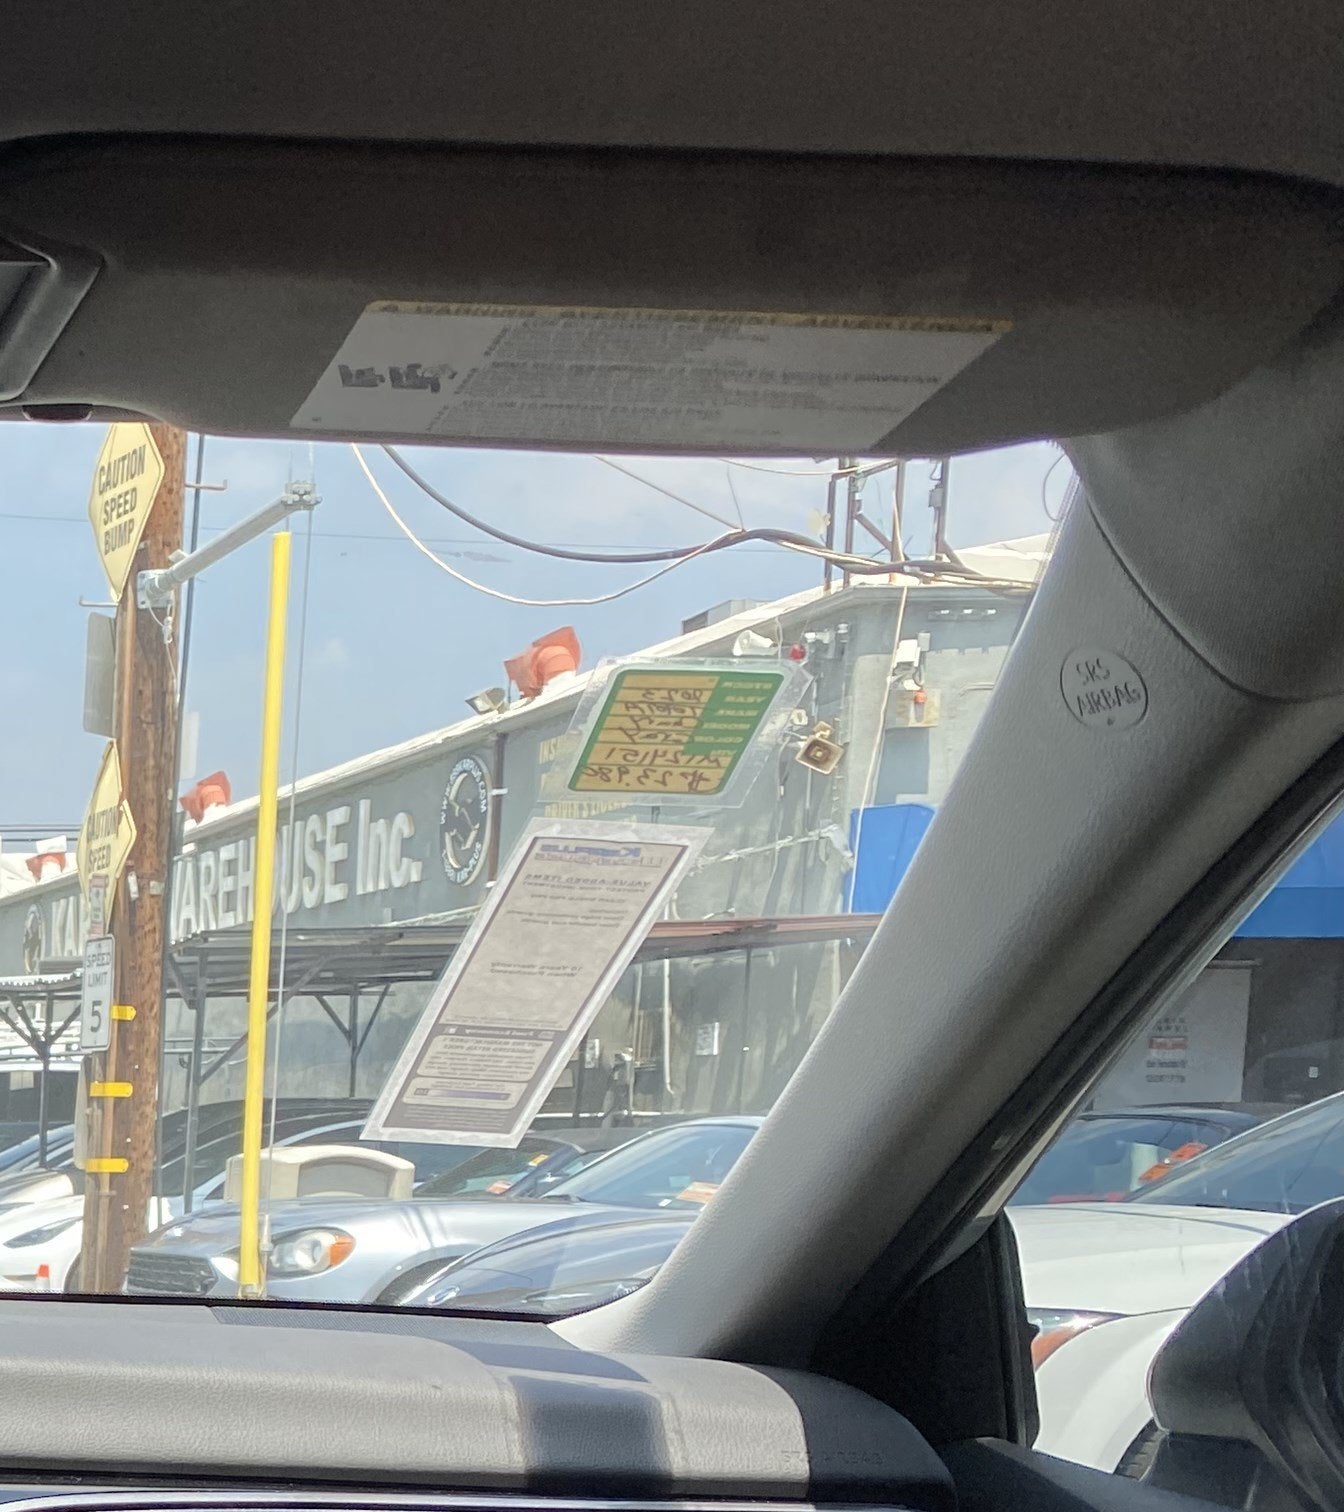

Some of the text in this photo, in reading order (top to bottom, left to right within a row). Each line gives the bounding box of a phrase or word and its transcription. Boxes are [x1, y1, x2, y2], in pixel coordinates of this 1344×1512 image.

[98, 444, 146, 495] CAUTION
[103, 487, 137, 526] SPEED
[104, 518, 135, 555] BUMP
[170, 805, 351, 944] AREHUSE
[356, 798, 423, 896] Inc.
[86, 951, 111, 969] SPEED
[88, 971, 109, 987] LIMIT
[90, 1000, 102, 1034] 5
